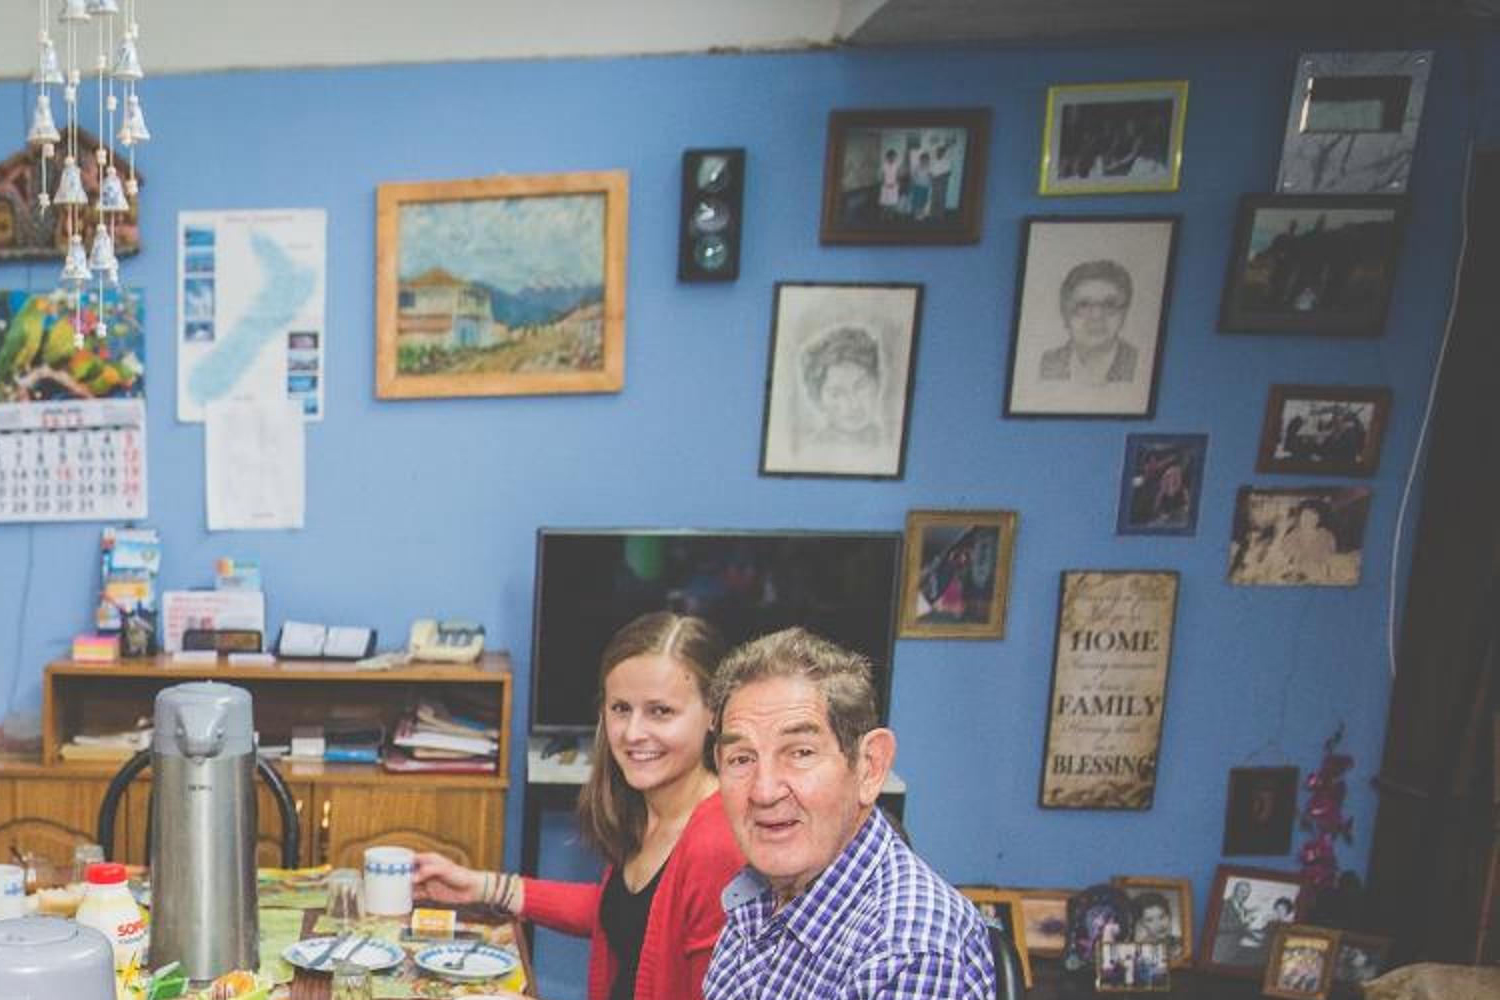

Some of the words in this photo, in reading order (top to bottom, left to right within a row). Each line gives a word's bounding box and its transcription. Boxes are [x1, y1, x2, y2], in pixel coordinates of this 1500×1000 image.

[1070, 630, 1159, 651] HOME
[1057, 695, 1161, 716] FAMILY
[1053, 754, 1156, 776] BLESSING
